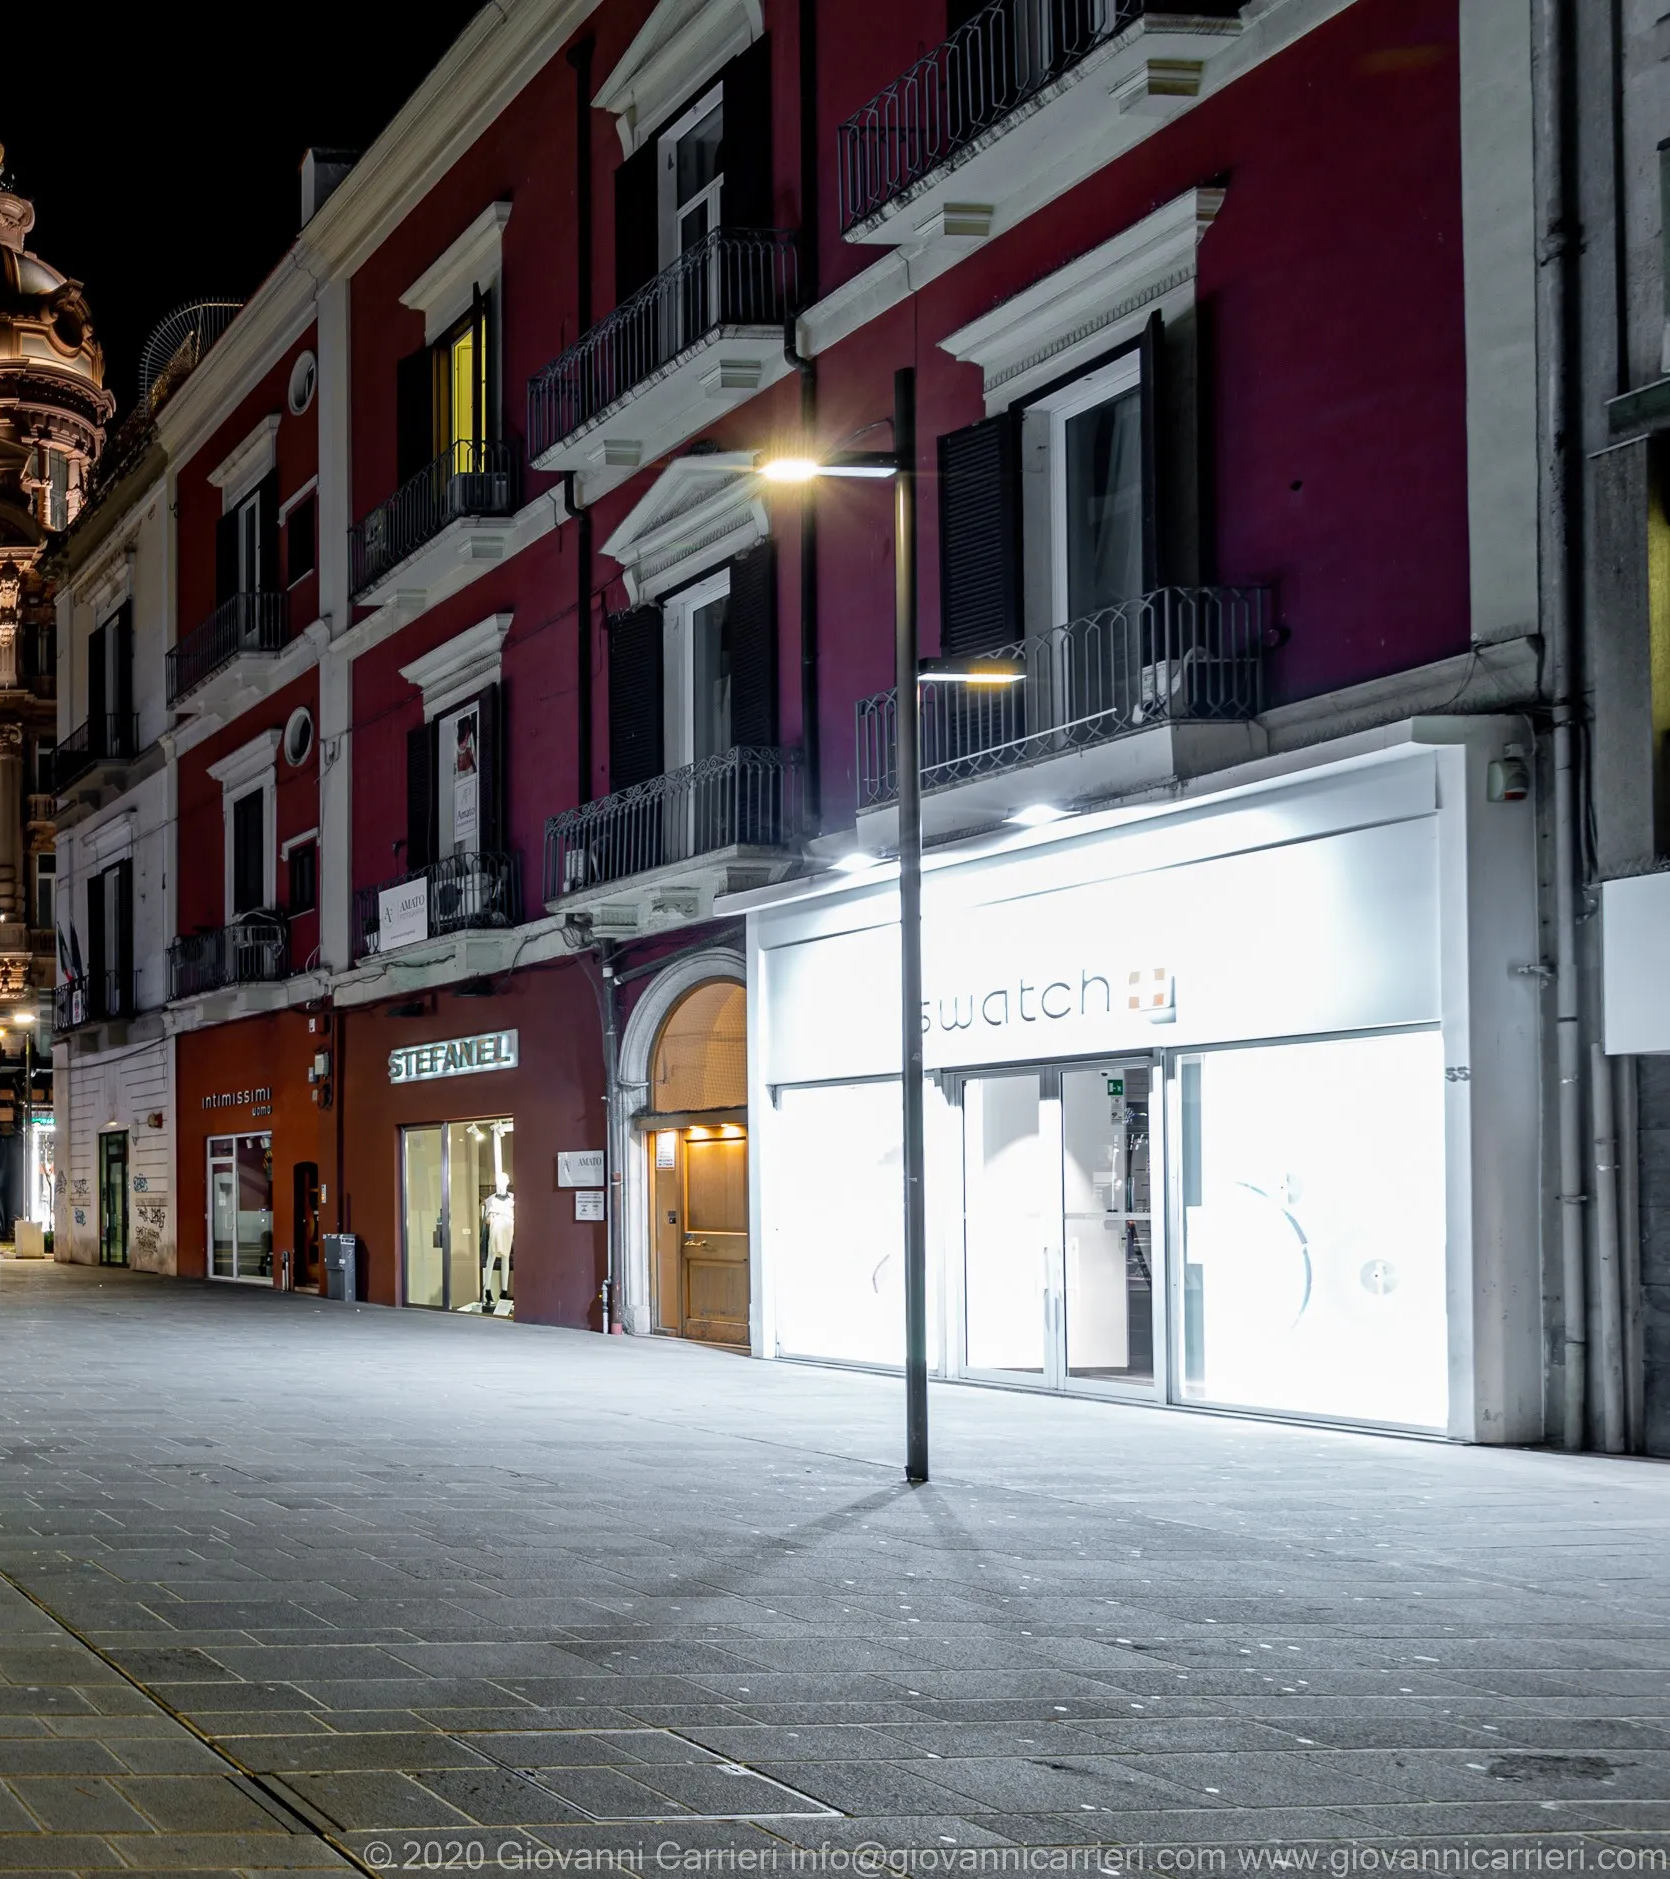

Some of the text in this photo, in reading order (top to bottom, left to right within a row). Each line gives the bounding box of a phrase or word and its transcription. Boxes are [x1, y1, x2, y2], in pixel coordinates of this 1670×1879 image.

[399, 894, 426, 912] AMATO
[388, 1035, 511, 1078] STEFANEL
[201, 1087, 271, 1109] intimissimi
[251, 1105, 272, 1117] uomo
[578, 1157, 602, 1167] AMATO
